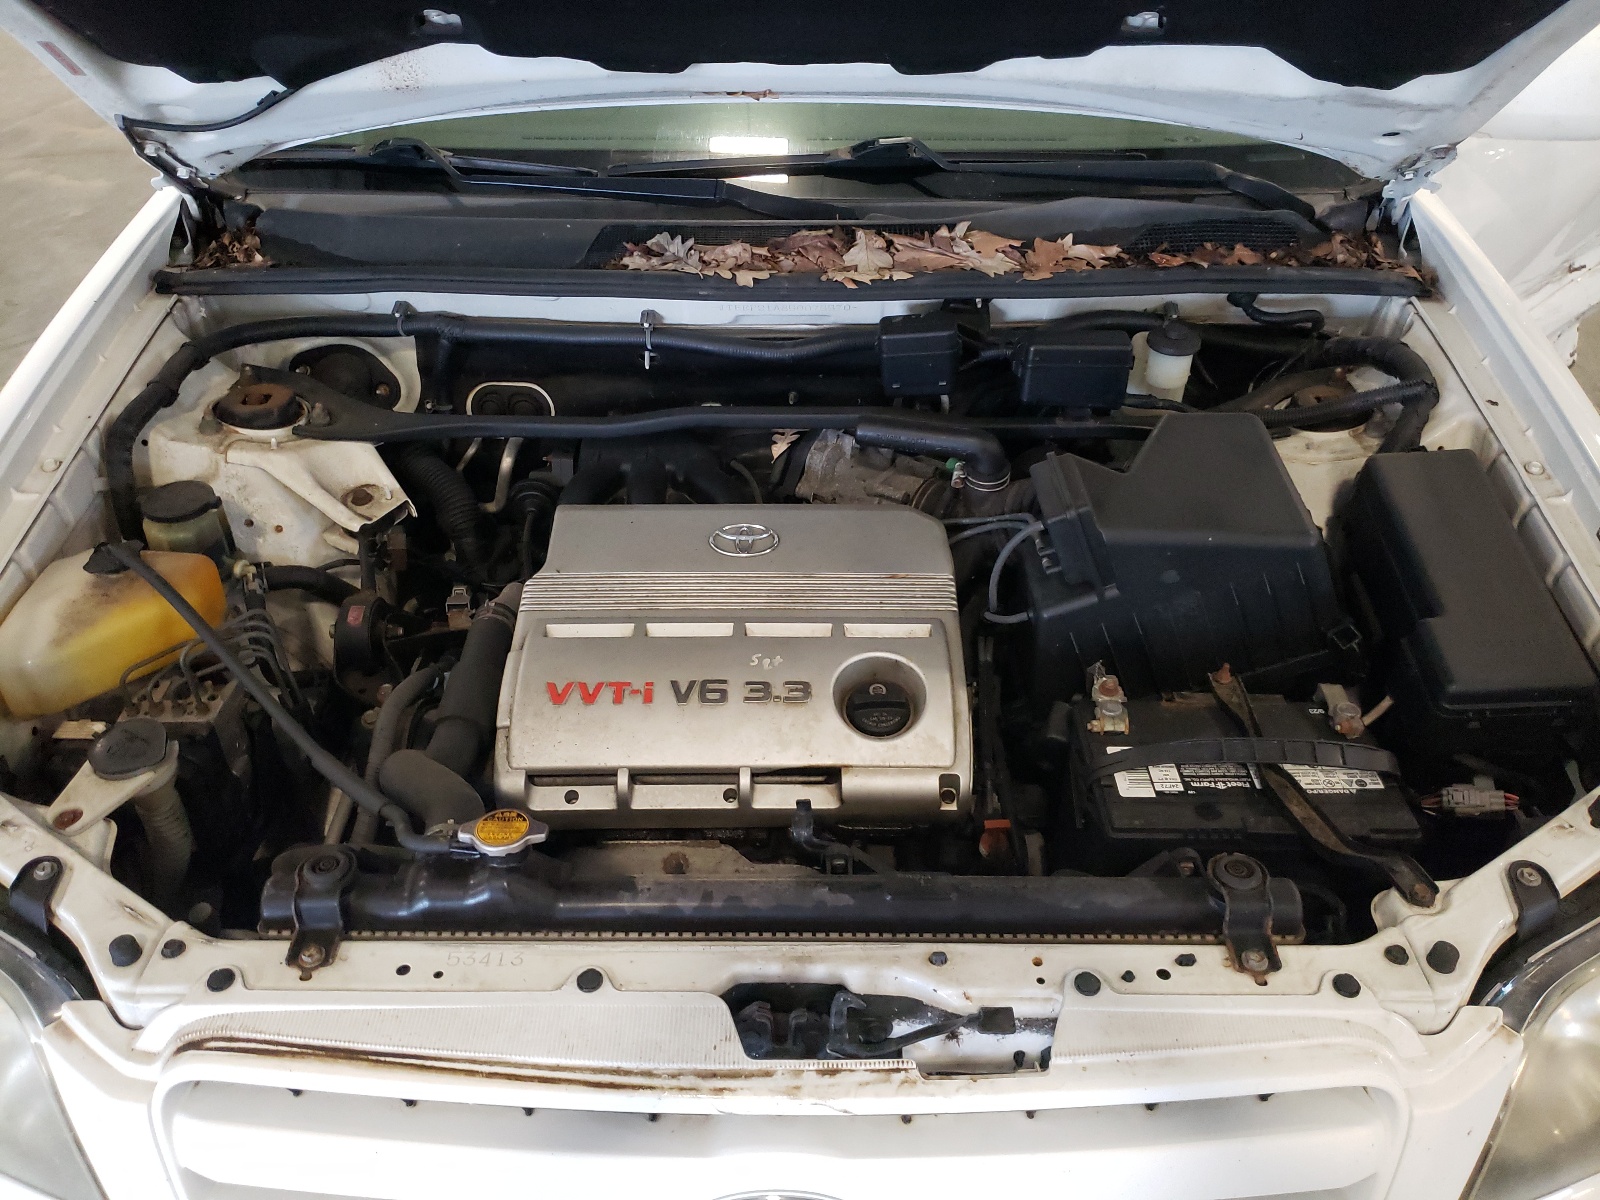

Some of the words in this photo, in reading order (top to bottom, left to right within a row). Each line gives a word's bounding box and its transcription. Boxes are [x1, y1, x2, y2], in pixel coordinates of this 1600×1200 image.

[546, 680, 655, 706] VVT-i
[669, 679, 729, 706] V6
[742, 680, 813, 705] 3.3
[446, 950, 524, 967] 53413
